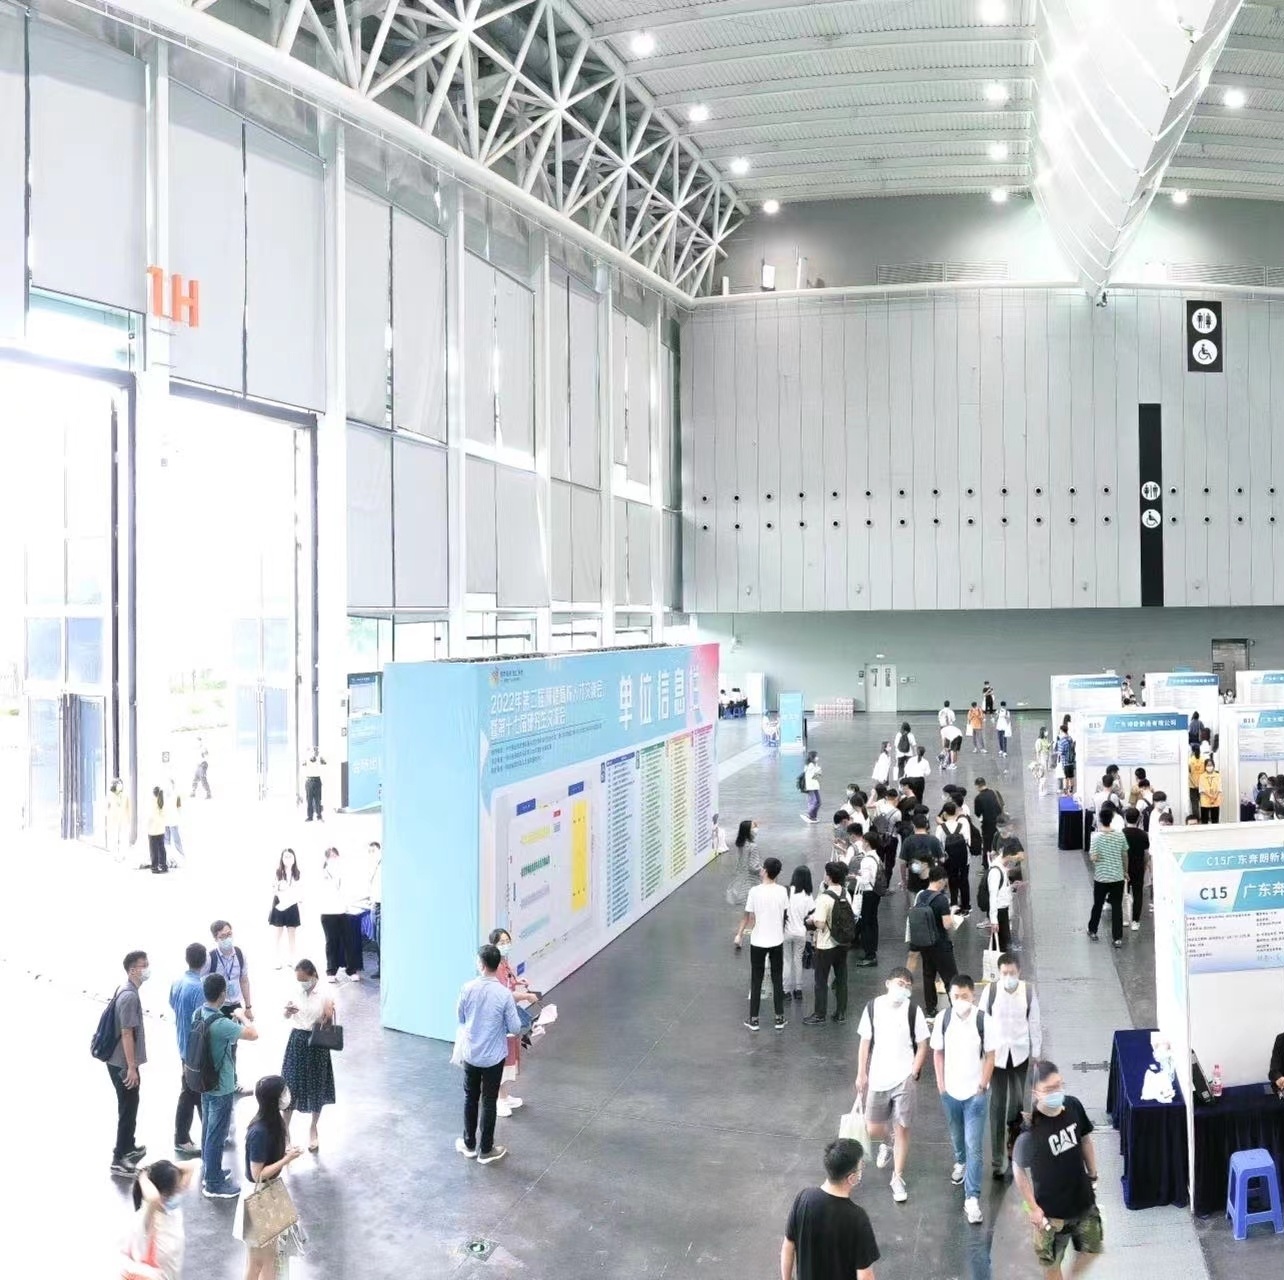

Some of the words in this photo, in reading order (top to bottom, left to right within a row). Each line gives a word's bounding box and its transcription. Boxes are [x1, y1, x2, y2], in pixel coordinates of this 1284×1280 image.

[147, 266, 199, 327] 1H
[1200, 886, 1228, 900] C15
[1048, 1122, 1077, 1156] CAT
